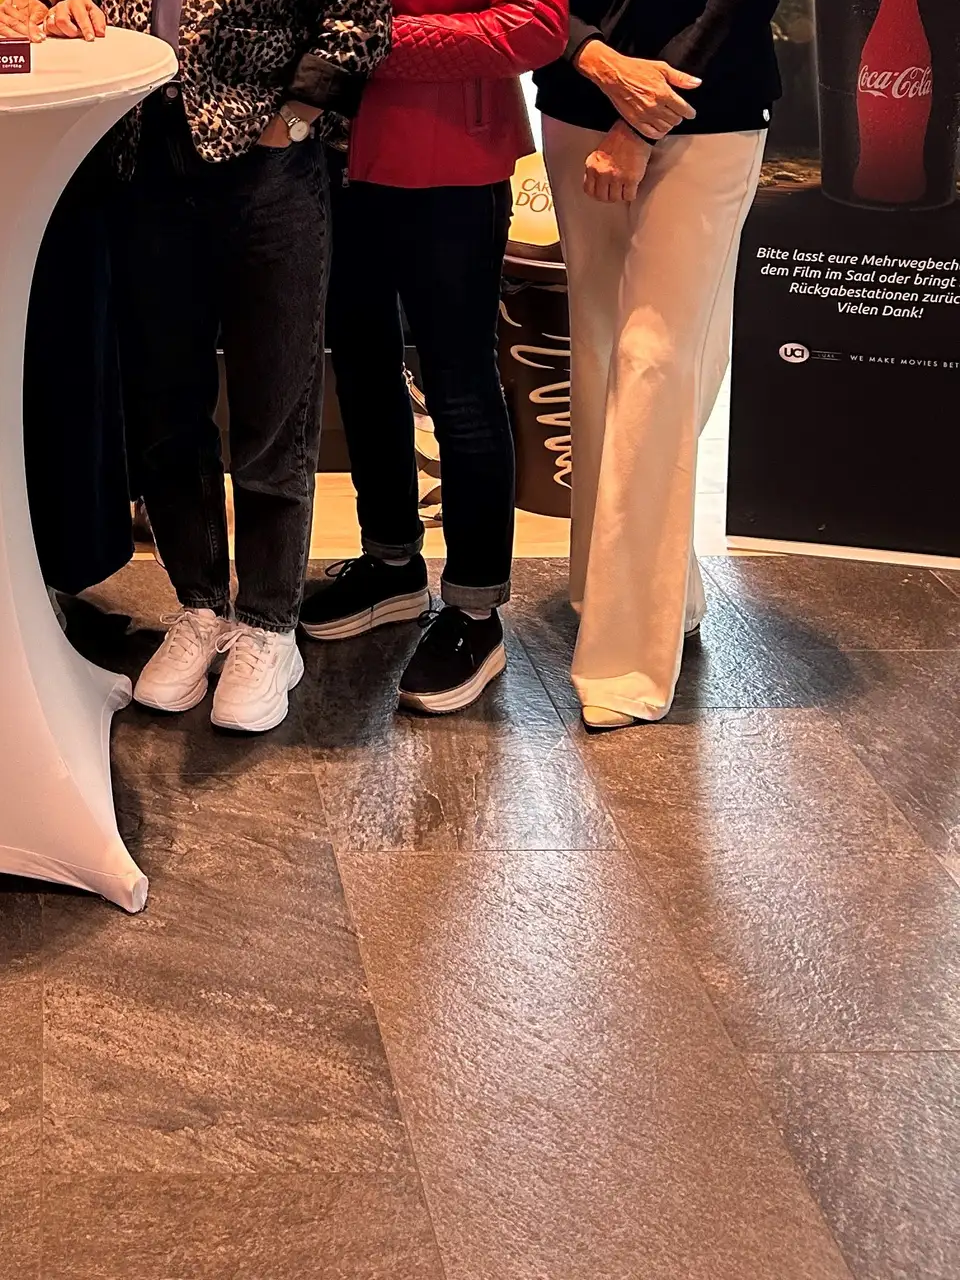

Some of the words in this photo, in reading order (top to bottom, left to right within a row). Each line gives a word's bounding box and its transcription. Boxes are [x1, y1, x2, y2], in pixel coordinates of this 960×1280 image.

[857, 64, 933, 99] Coca-Cola
[522, 178, 551, 196] CAR
[756, 247, 789, 261] Bitte
[792, 249, 825, 263] lasst
[828, 254, 858, 265] eure
[861, 254, 960, 272] Mehrwegbech
[760, 264, 789, 277] dem
[792, 266, 822, 280] Film
[825, 268, 842, 281] im
[845, 269, 875, 283] Saal
[878, 272, 910, 285] oder
[913, 273, 957, 290] bringt
[789, 282, 919, 302] Rückgabestationen
[837, 302, 878, 316] Vielen
[882, 304, 924, 319] Dank!
[784, 347, 804, 359] UCI
[850, 354, 864, 362] WE
[869, 356, 895, 364] MAKE
[900, 358, 938, 367] MOVIES
